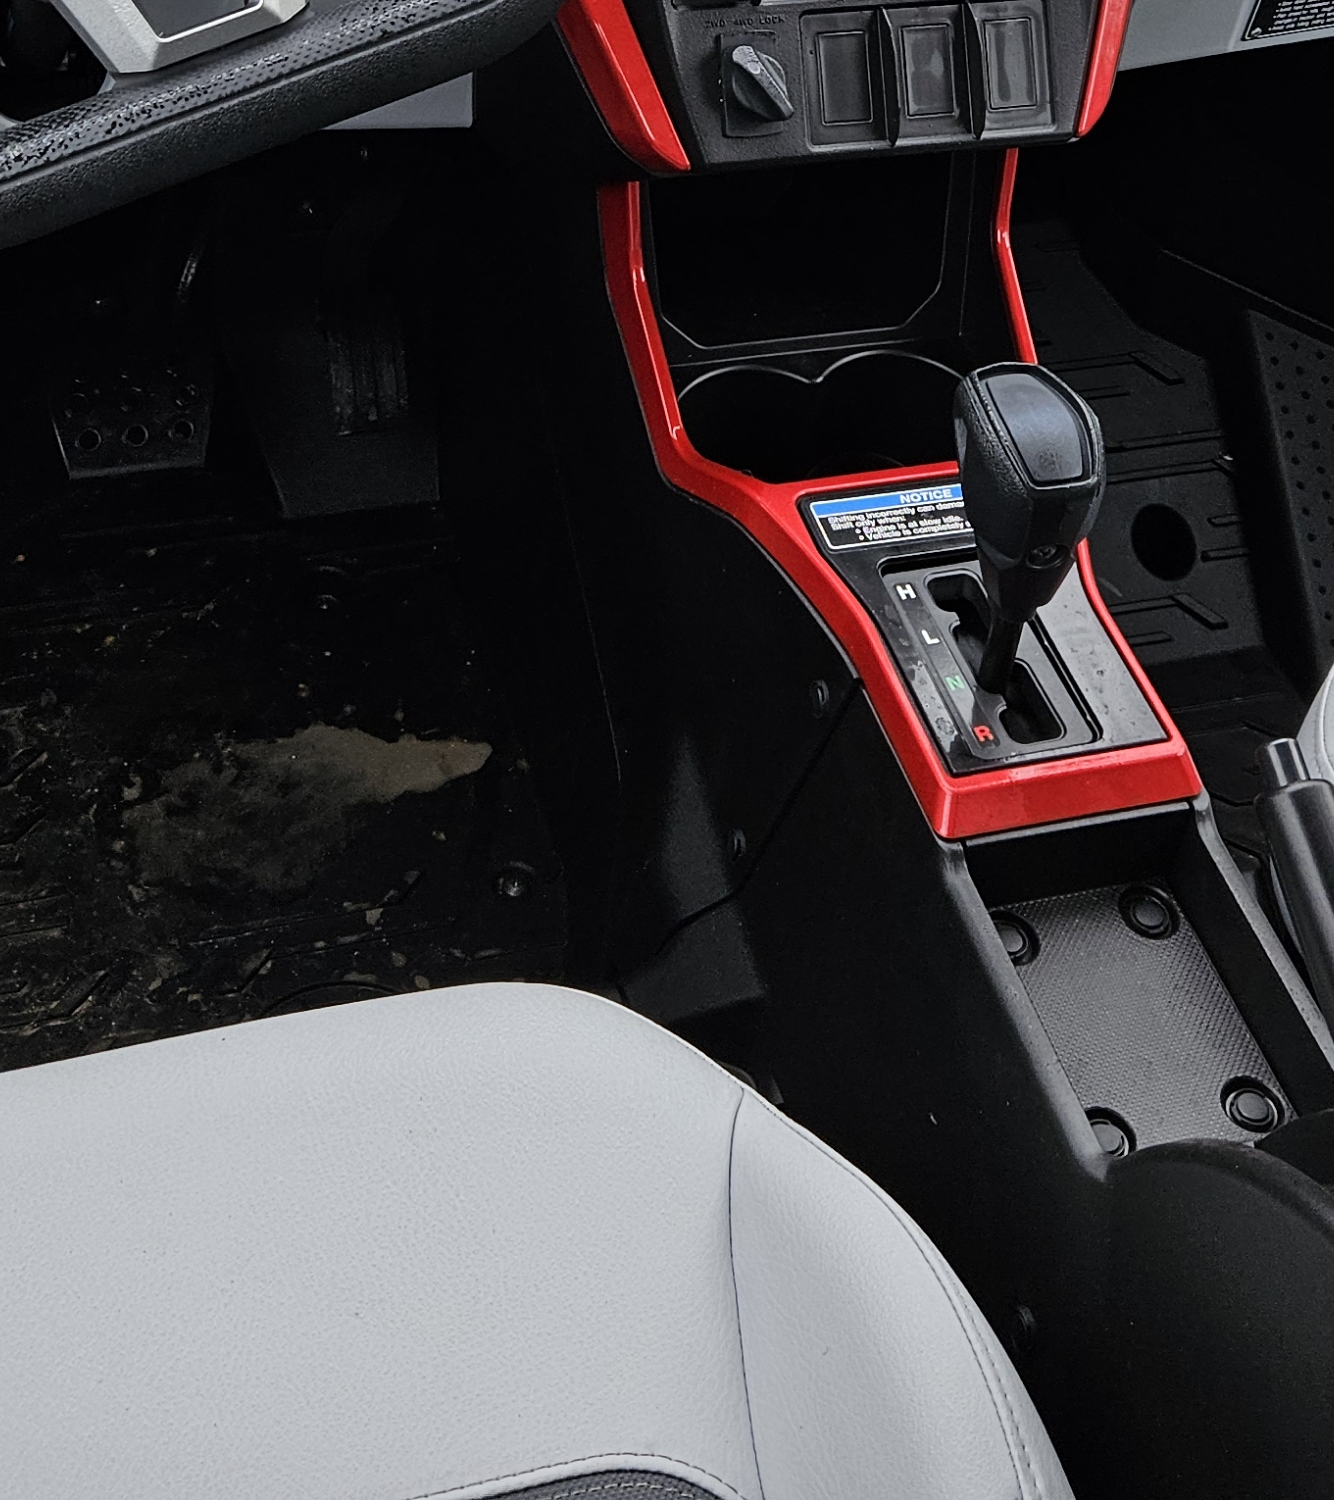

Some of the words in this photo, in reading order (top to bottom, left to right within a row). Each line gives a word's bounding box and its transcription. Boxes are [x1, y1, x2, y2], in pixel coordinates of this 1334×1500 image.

[759, 15, 785, 24] LOCK
[899, 488, 952, 504] NOTICE
[828, 514, 866, 524] Shifting
[865, 507, 915, 518] incorrectly
[831, 521, 854, 531] Shift
[855, 519, 875, 528] only
[864, 530, 901, 541] Vehicle
[913, 522, 963, 534] completely
[896, 522, 907, 530] is
[908, 520, 918, 528] at
[919, 518, 941, 527] slow
[895, 583, 917, 600] H
[921, 629, 940, 645] L
[945, 675, 966, 691] N
[973, 725, 994, 742] R
